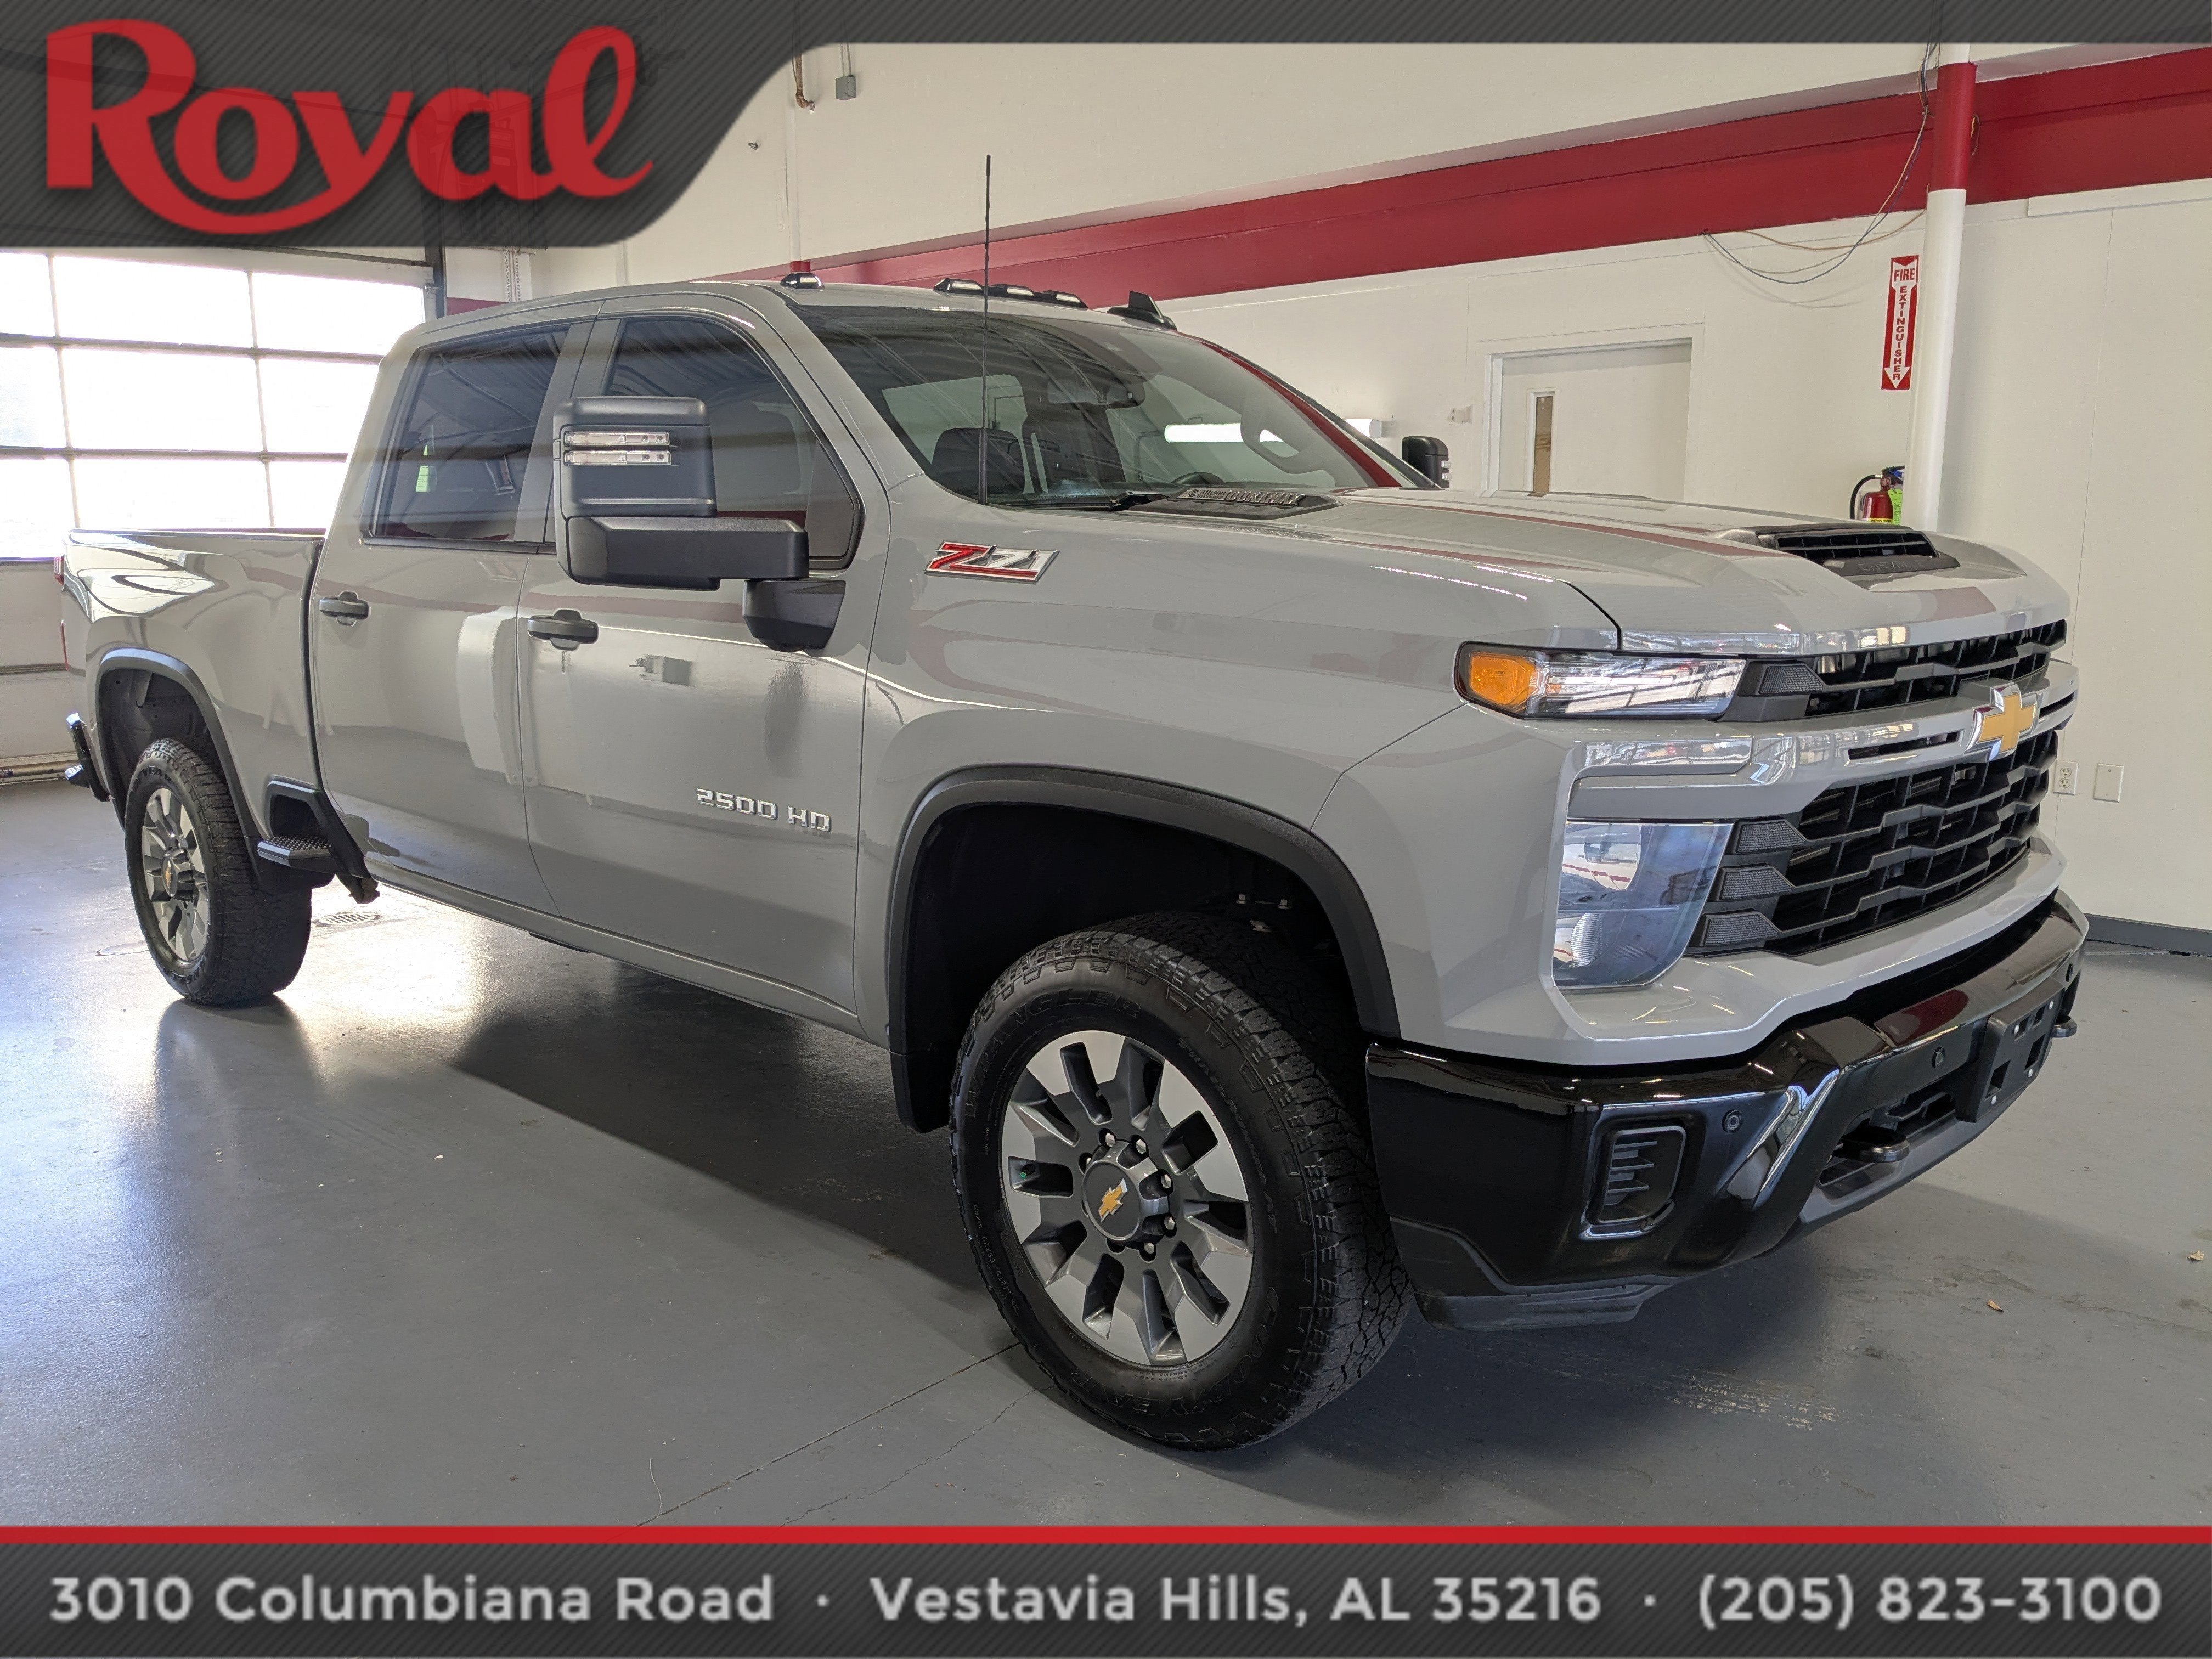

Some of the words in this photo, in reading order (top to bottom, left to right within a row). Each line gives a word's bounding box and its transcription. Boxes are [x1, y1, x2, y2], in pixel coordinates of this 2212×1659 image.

[1894, 268, 1915, 282] FIRE
[1892, 285, 1908, 381] EXTINGUISHER
[1225, 489, 1305, 506] DURAMAX
[924, 540, 1060, 585] Z71
[696, 787, 778, 820] 2500
[787, 806, 832, 832] HD
[964, 988, 1141, 1118] WRANGLER
[1070, 1286, 1279, 1417] GOODYEAR
